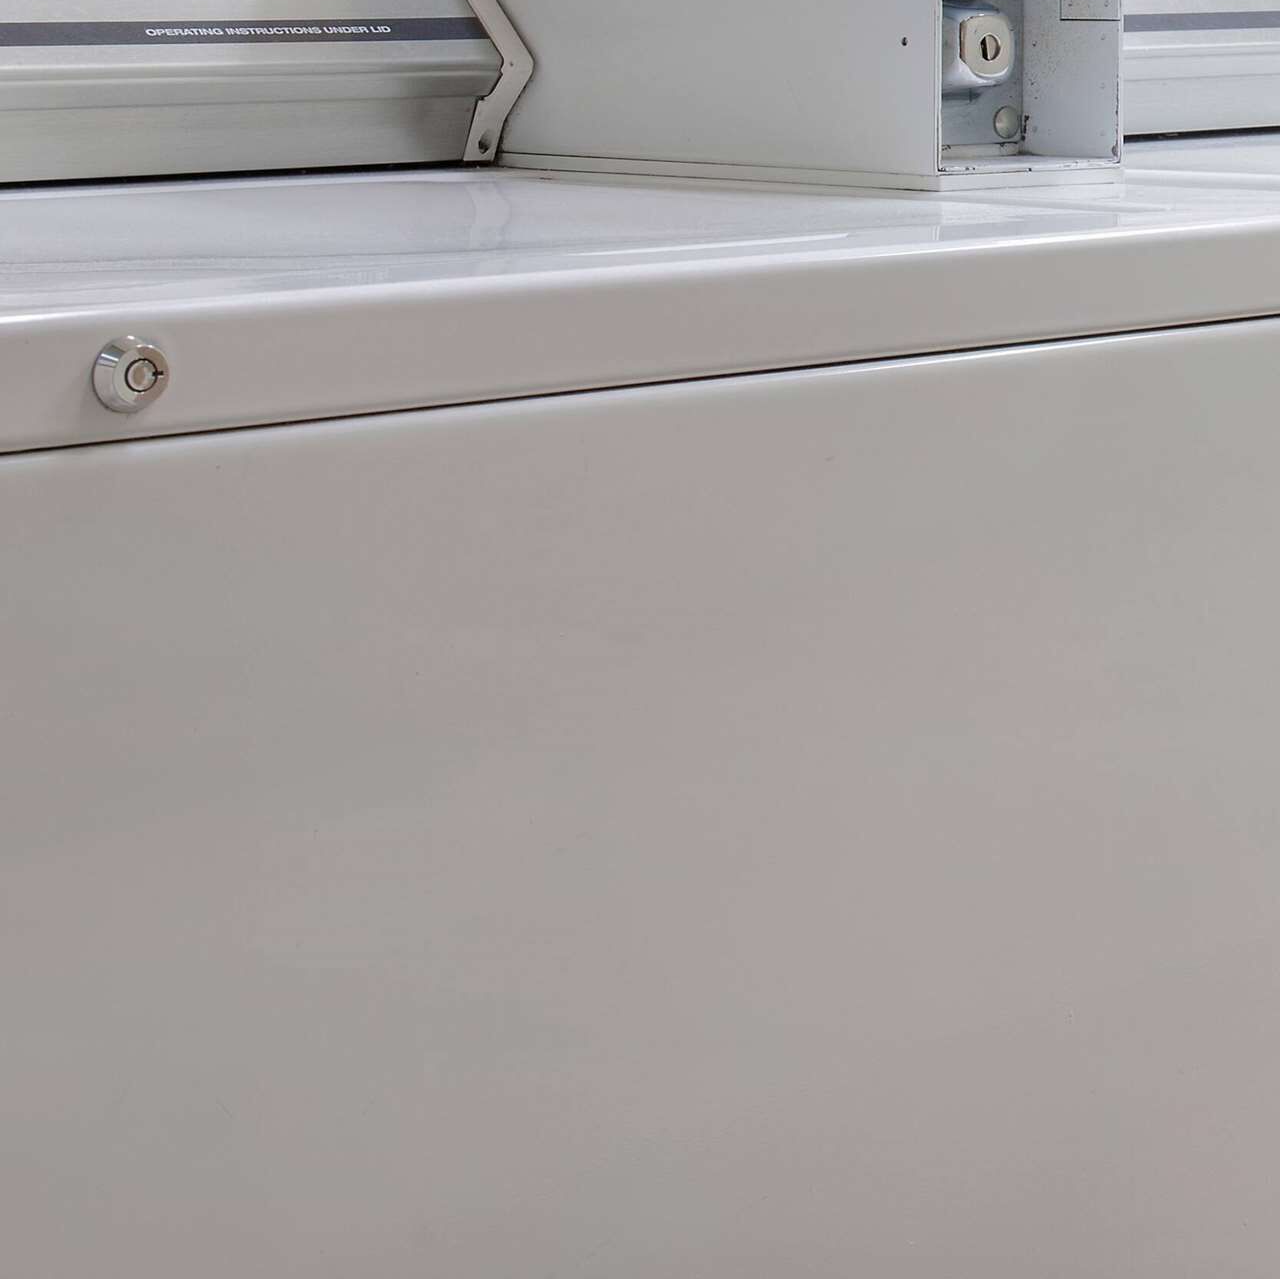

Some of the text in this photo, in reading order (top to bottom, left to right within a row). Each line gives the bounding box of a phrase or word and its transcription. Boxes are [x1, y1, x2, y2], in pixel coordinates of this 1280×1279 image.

[145, 25, 391, 36] OPERATING INSTRUCTIONS UNDER LID
